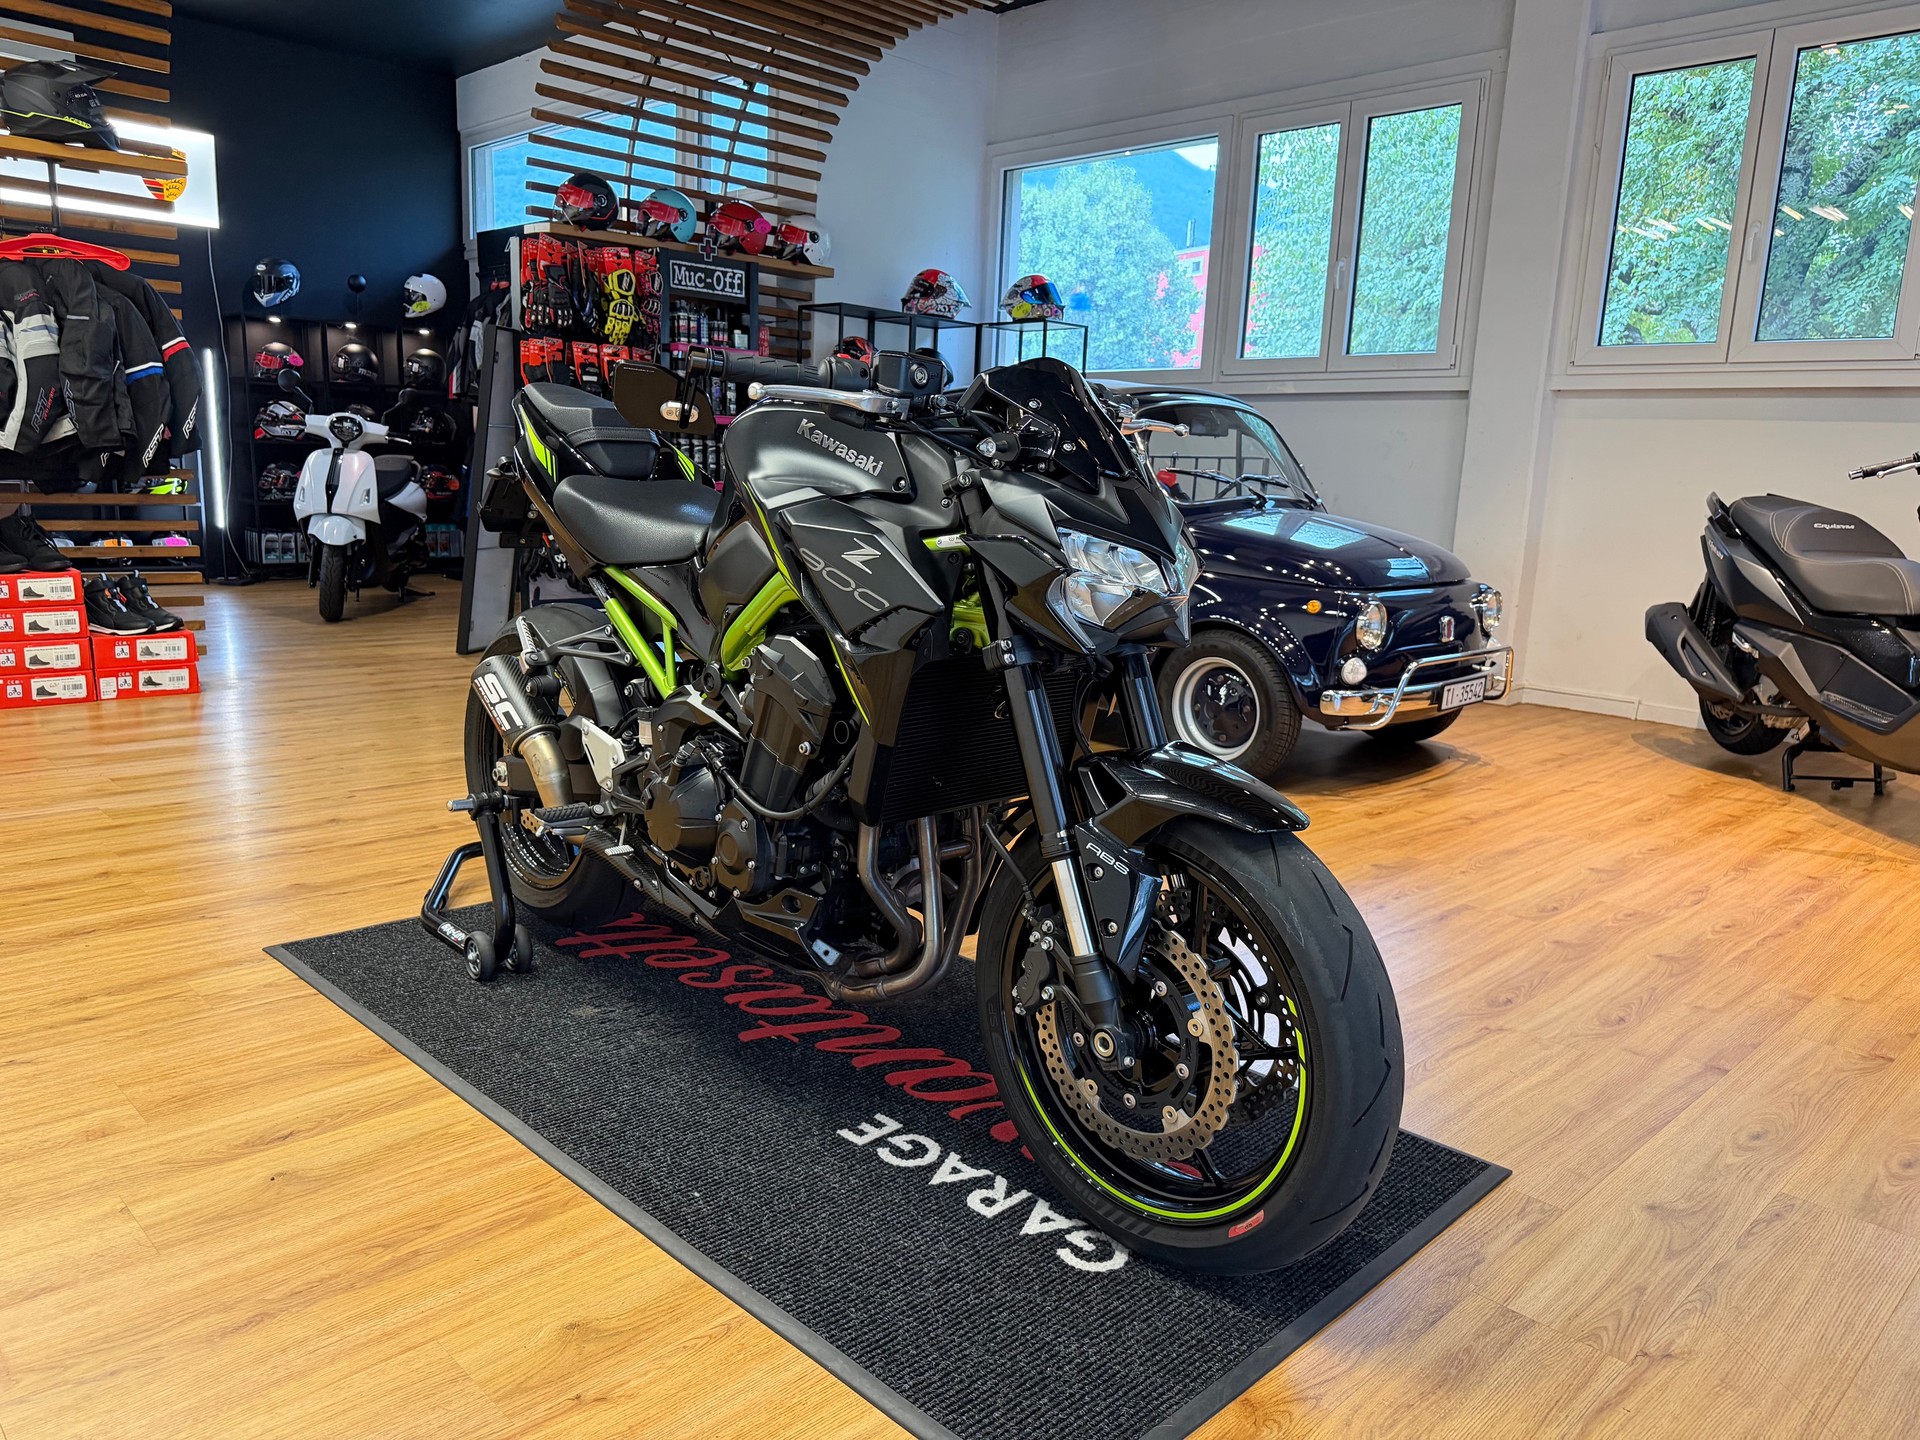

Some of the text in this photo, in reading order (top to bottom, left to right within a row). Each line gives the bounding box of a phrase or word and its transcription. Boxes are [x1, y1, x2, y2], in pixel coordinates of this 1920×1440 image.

[673, 265, 742, 294] Muc-Off
[31, 387, 46, 434] RST
[182, 396, 199, 440] RS
[142, 423, 165, 469] RST
[796, 418, 884, 477] Kawasaki
[799, 547, 890, 612] 900
[477, 672, 524, 730] SC
[1085, 842, 1130, 875] ABS
[836, 1112, 1131, 1273] GARAGE
